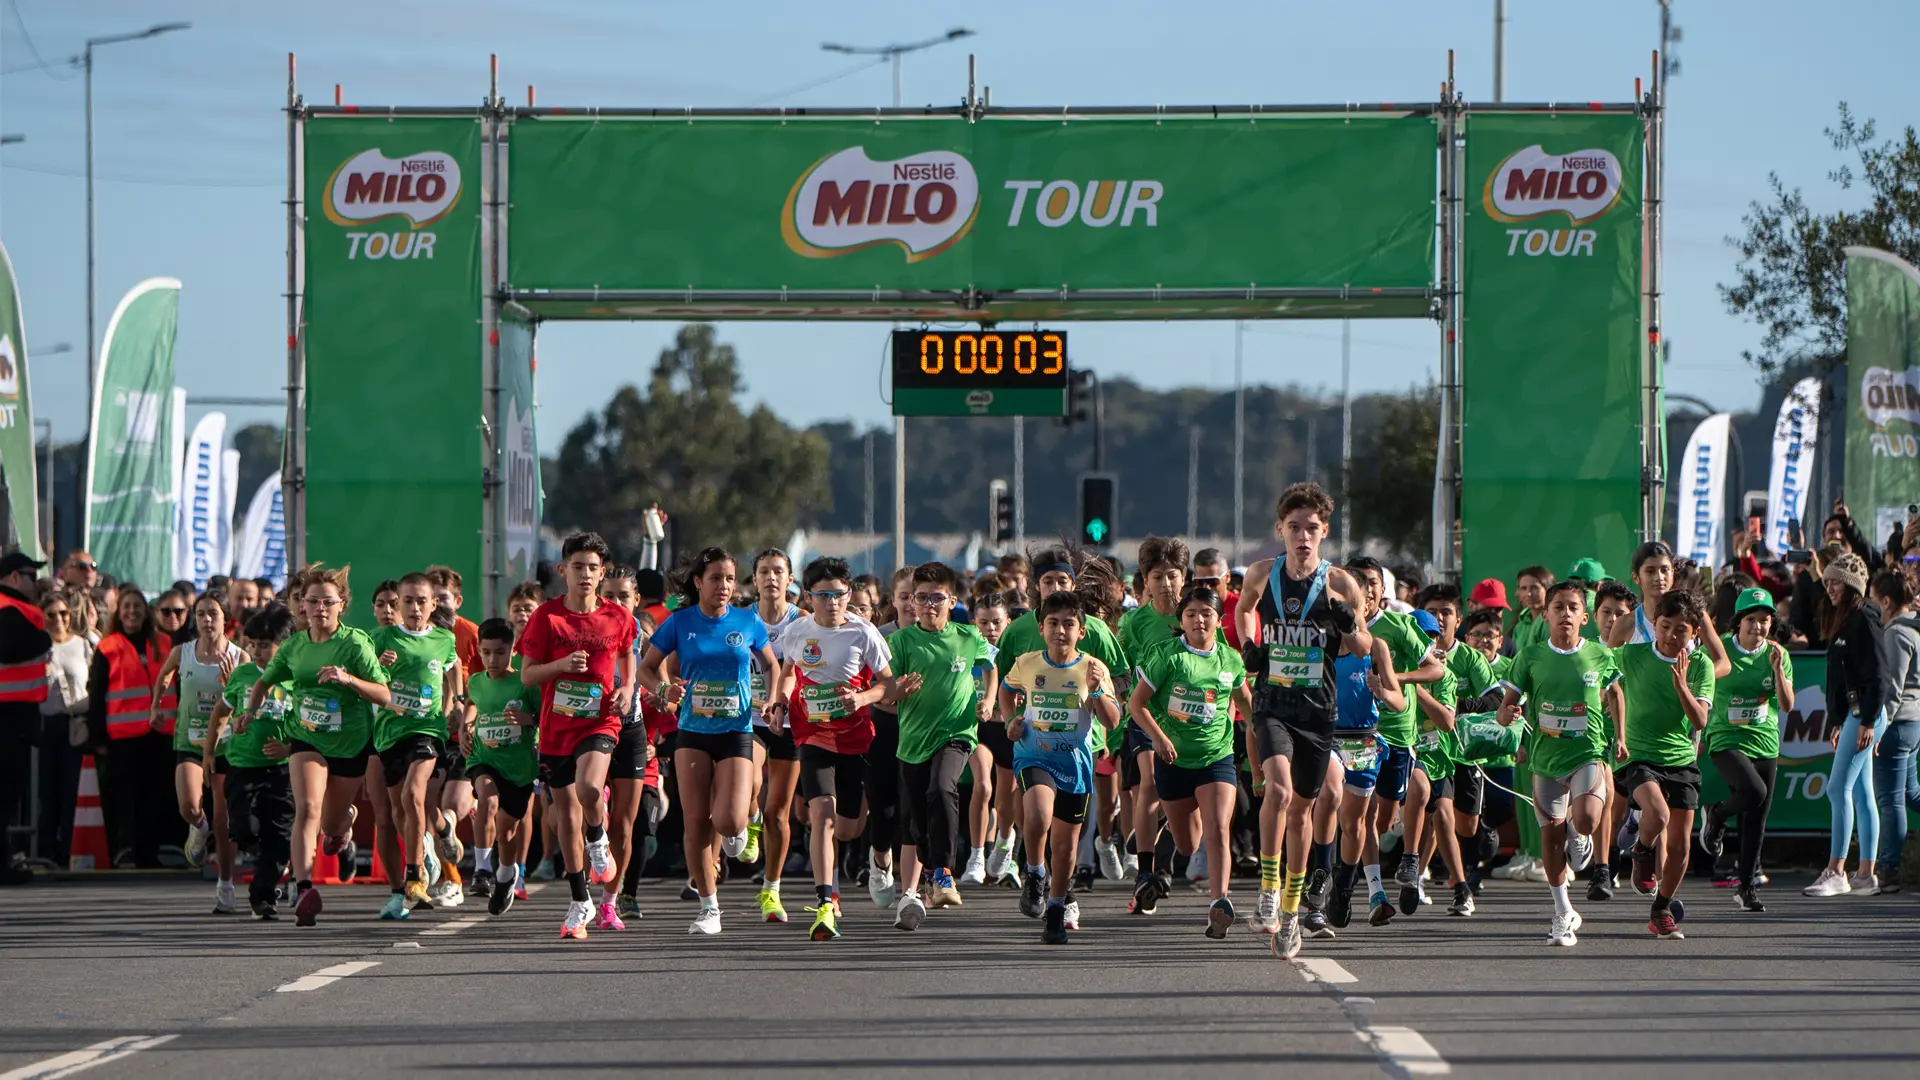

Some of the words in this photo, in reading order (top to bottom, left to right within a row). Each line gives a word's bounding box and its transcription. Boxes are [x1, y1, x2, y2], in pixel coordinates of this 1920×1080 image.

[401, 159, 447, 175] Nestlé
[1561, 155, 1608, 171] Nestlé
[893, 162, 959, 182] Nestlé
[344, 172, 447, 205] MILO
[1504, 168, 1608, 201] MILO
[812, 180, 959, 227] MILO
[1003, 179, 1165, 228] TOUR
[346, 231, 437, 261] TOUR
[1505, 228, 1597, 257] TOUR
[1281, 665, 1310, 676] 444
[396, 696, 421, 708] 1710
[567, 697, 589, 708] 757
[701, 698, 730, 708] 1207
[816, 700, 843, 712] 1736
[1180, 702, 1205, 714] 1118
[1037, 710, 1069, 721] 1009
[1741, 709, 1760, 718] 515
[1557, 719, 1568, 728] 11
[1783, 709, 1832, 744] MI
[486, 727, 511, 739] 1149
[1783, 773, 1828, 801] TO
